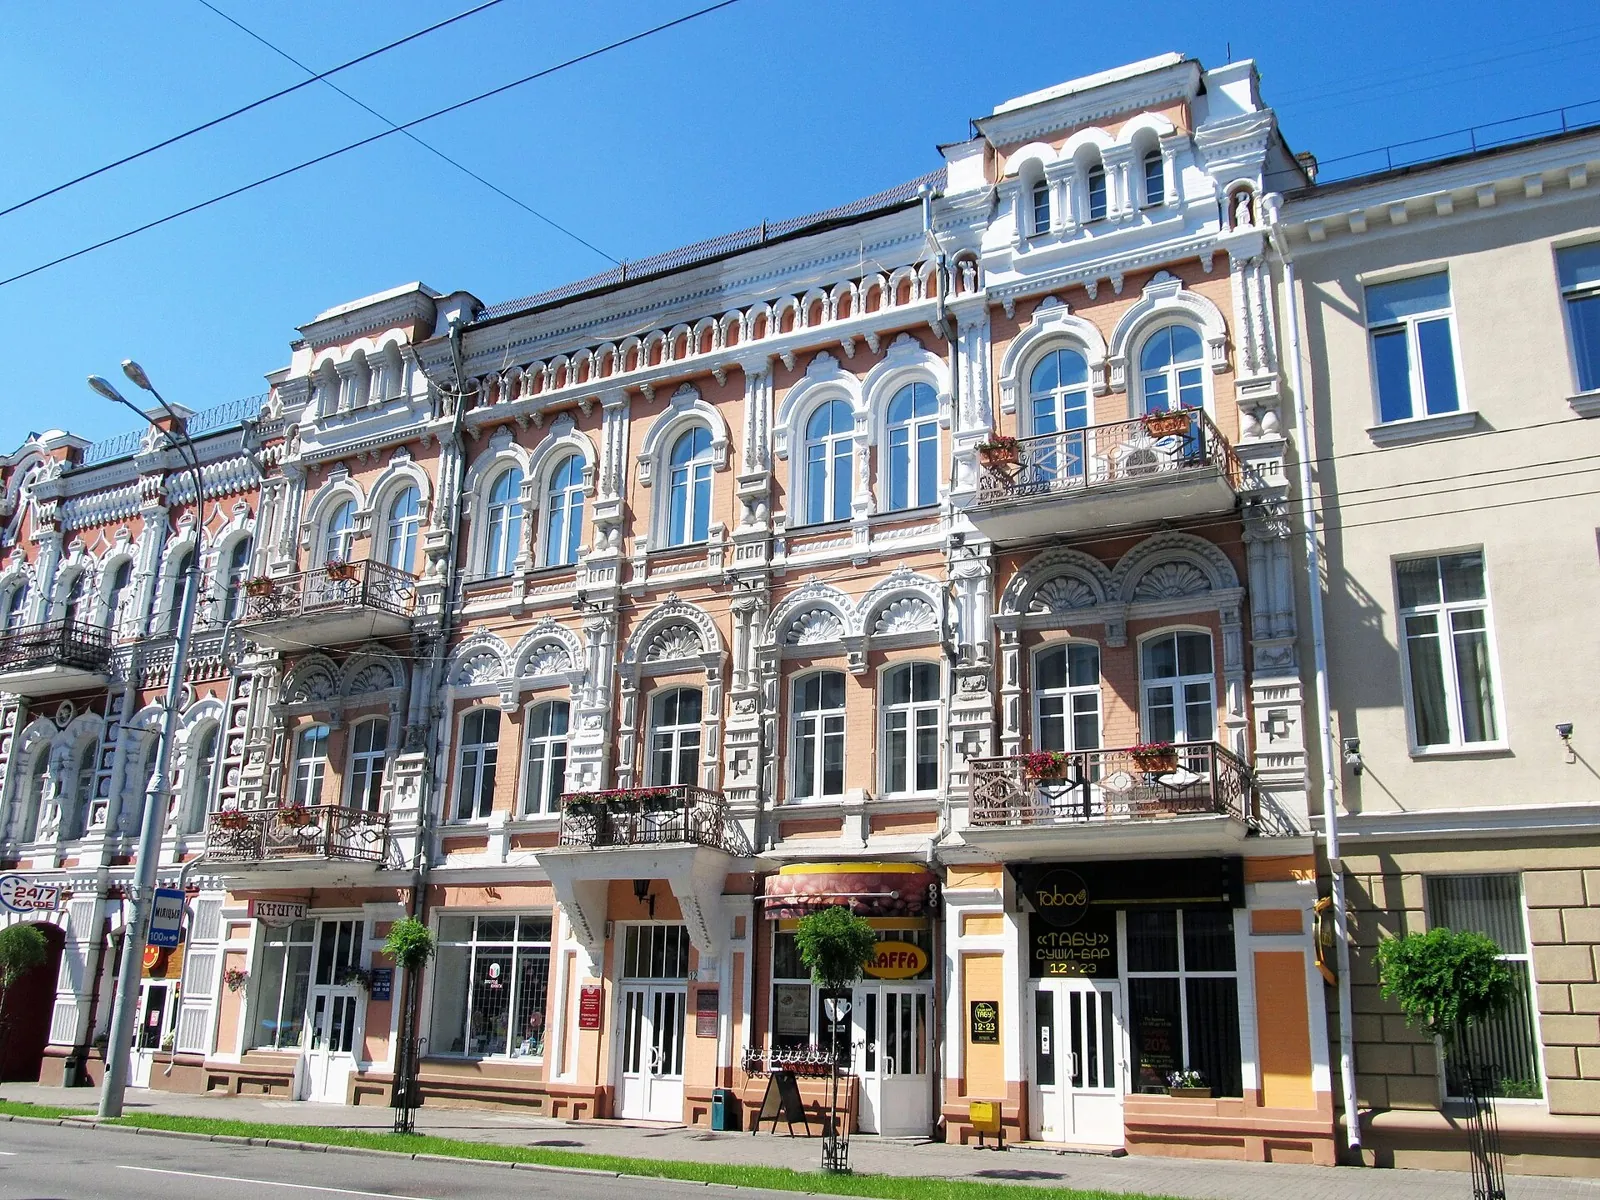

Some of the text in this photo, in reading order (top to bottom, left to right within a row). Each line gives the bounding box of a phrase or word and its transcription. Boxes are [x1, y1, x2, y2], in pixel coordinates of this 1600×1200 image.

[14, 886, 56, 900] 24/7
[1036, 884, 1087, 906] Taboo
[13, 898, 55, 908] КАФЕ
[257, 902, 303, 917] КНИГИ
[1037, 931, 1109, 946] «ТАБУ»
[1036, 947, 1110, 960] СУШИ-БАР
